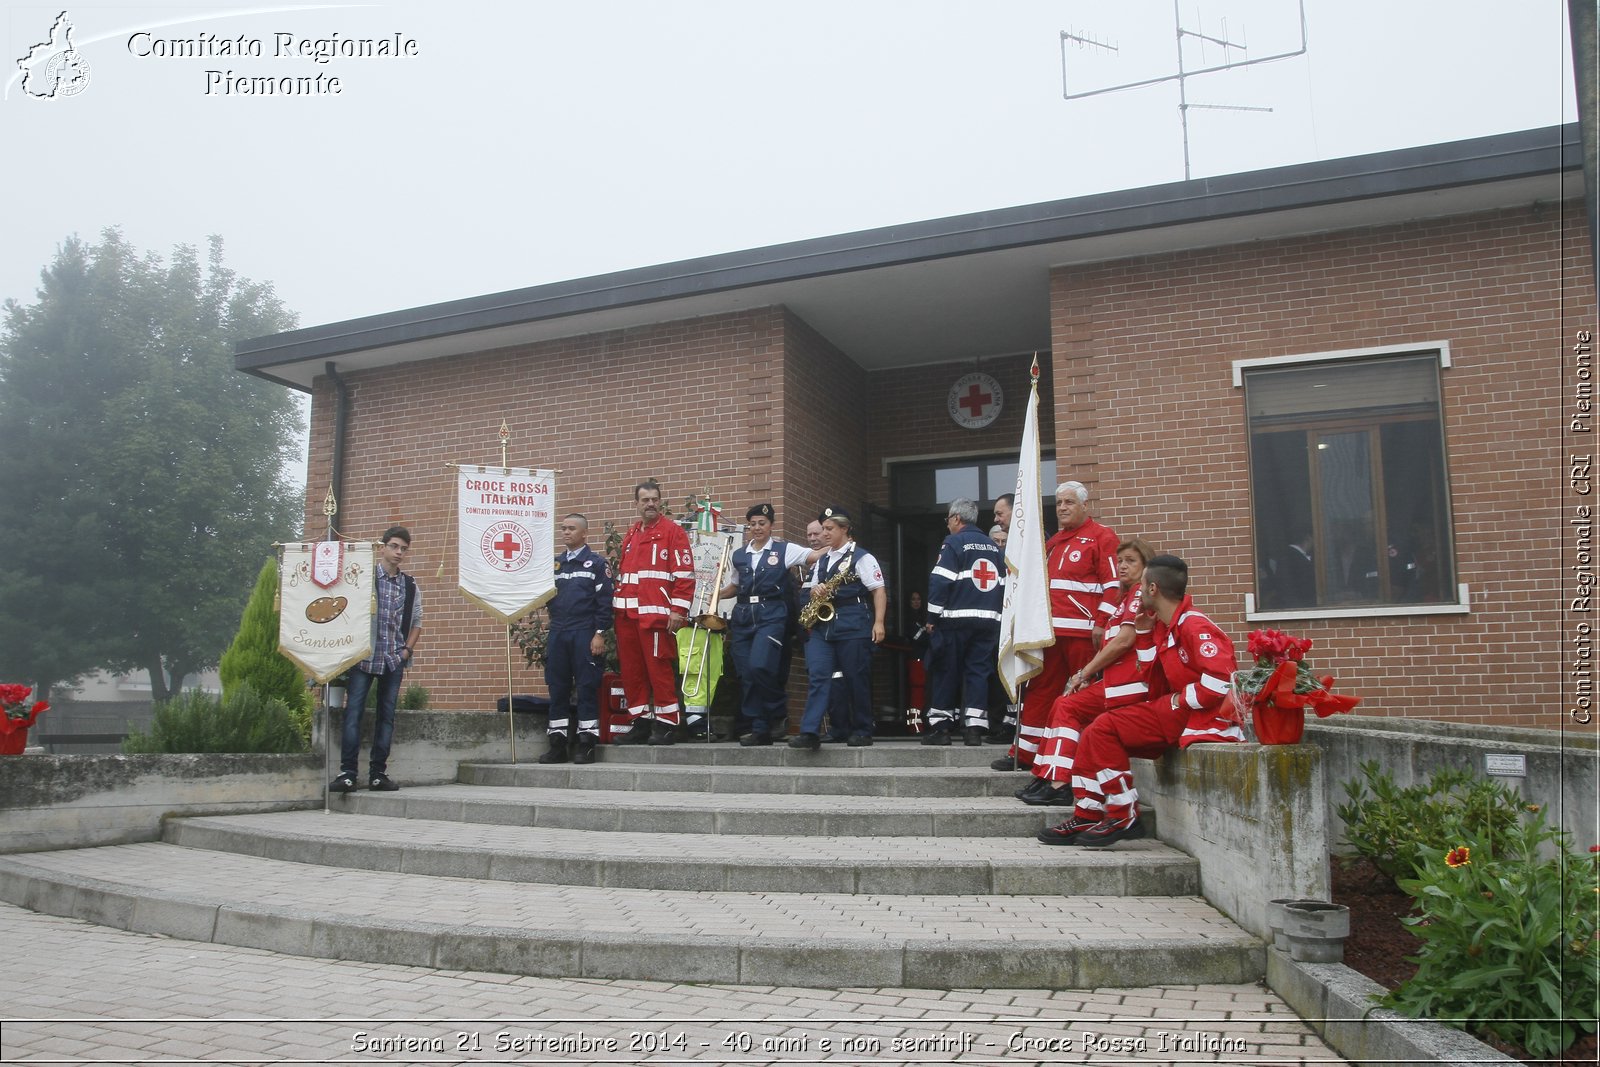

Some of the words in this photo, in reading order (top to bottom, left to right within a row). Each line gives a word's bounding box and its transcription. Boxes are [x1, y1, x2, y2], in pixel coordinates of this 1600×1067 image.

[466, 479, 505, 492] CROCE
[511, 482, 548, 495] ROSSA
[481, 493, 534, 506] ITALIANA
[466, 507, 490, 516] COMITATO
[492, 508, 523, 517] PROVINCIALE
[292, 628, 354, 649] Santena
